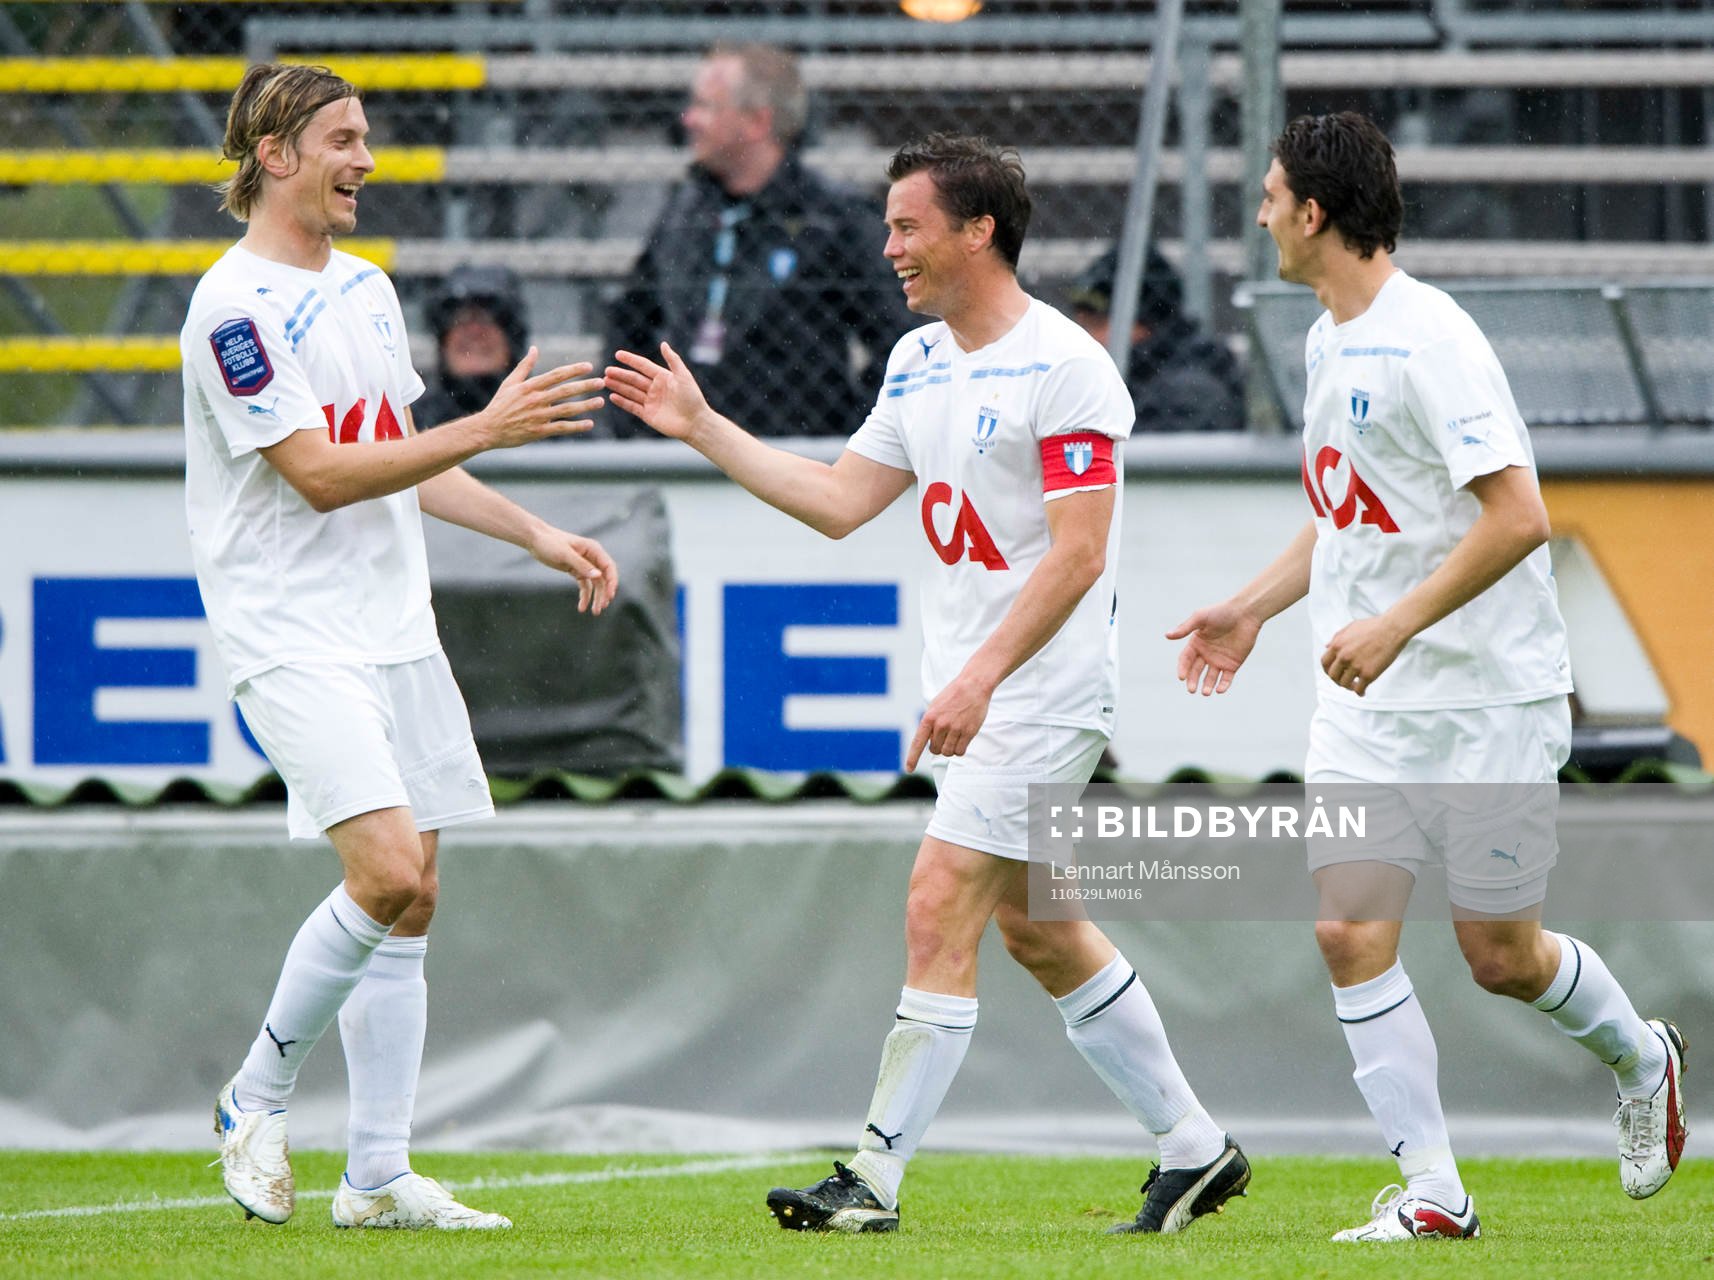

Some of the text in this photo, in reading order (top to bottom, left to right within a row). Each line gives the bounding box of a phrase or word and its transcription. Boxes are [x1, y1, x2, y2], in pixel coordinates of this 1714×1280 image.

[221, 339, 255, 358] SVERIGES
[225, 335, 244, 348] HELA
[223, 346, 259, 367] FOTBOLLS
